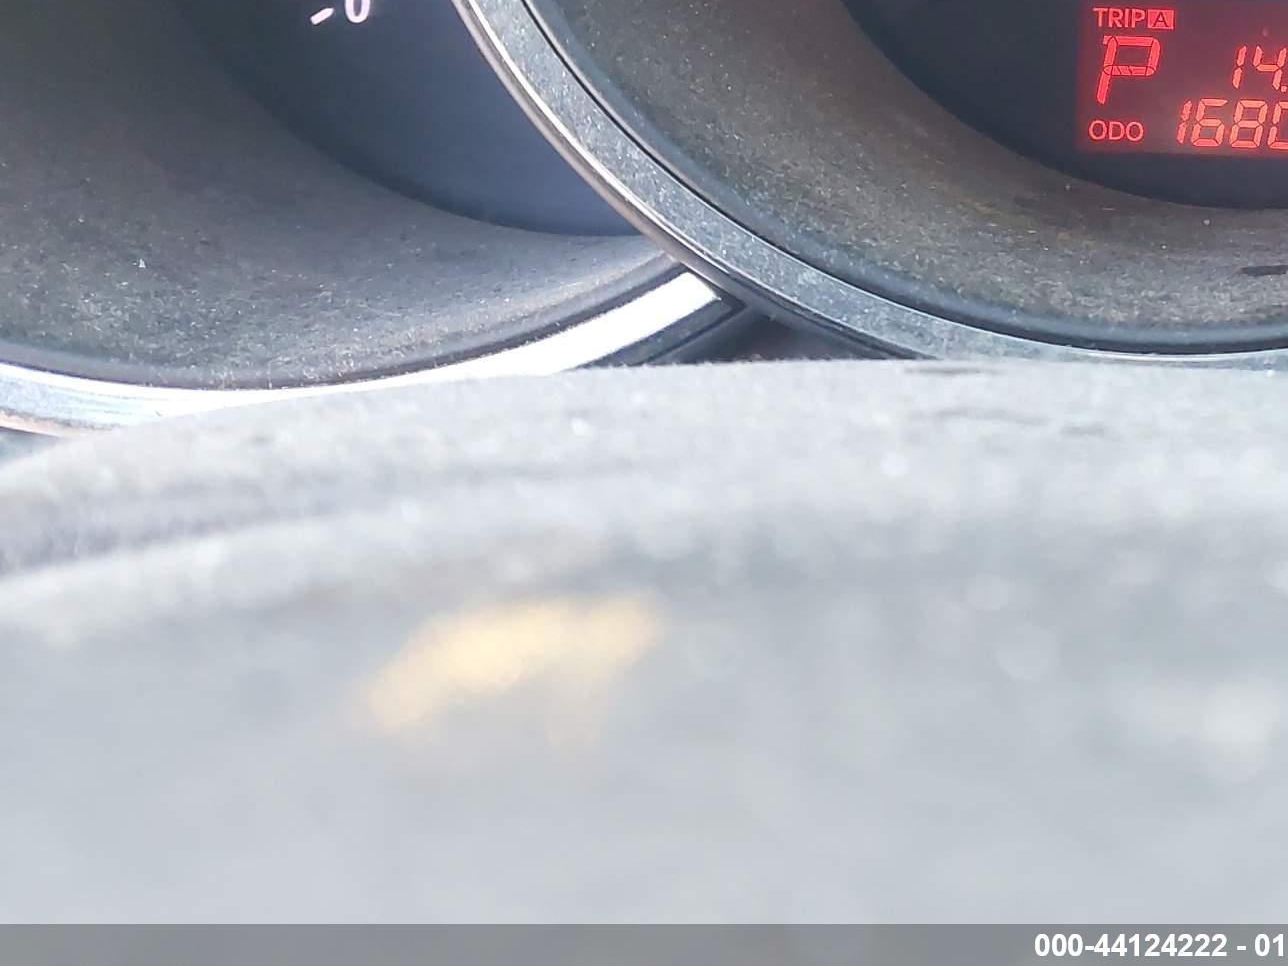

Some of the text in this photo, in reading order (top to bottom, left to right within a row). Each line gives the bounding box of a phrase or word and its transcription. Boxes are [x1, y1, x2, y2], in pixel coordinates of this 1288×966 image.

[1093, 7, 1146, 27] TRIP
[1096, 35, 1161, 105] P
[1088, 120, 1144, 142] ODO
